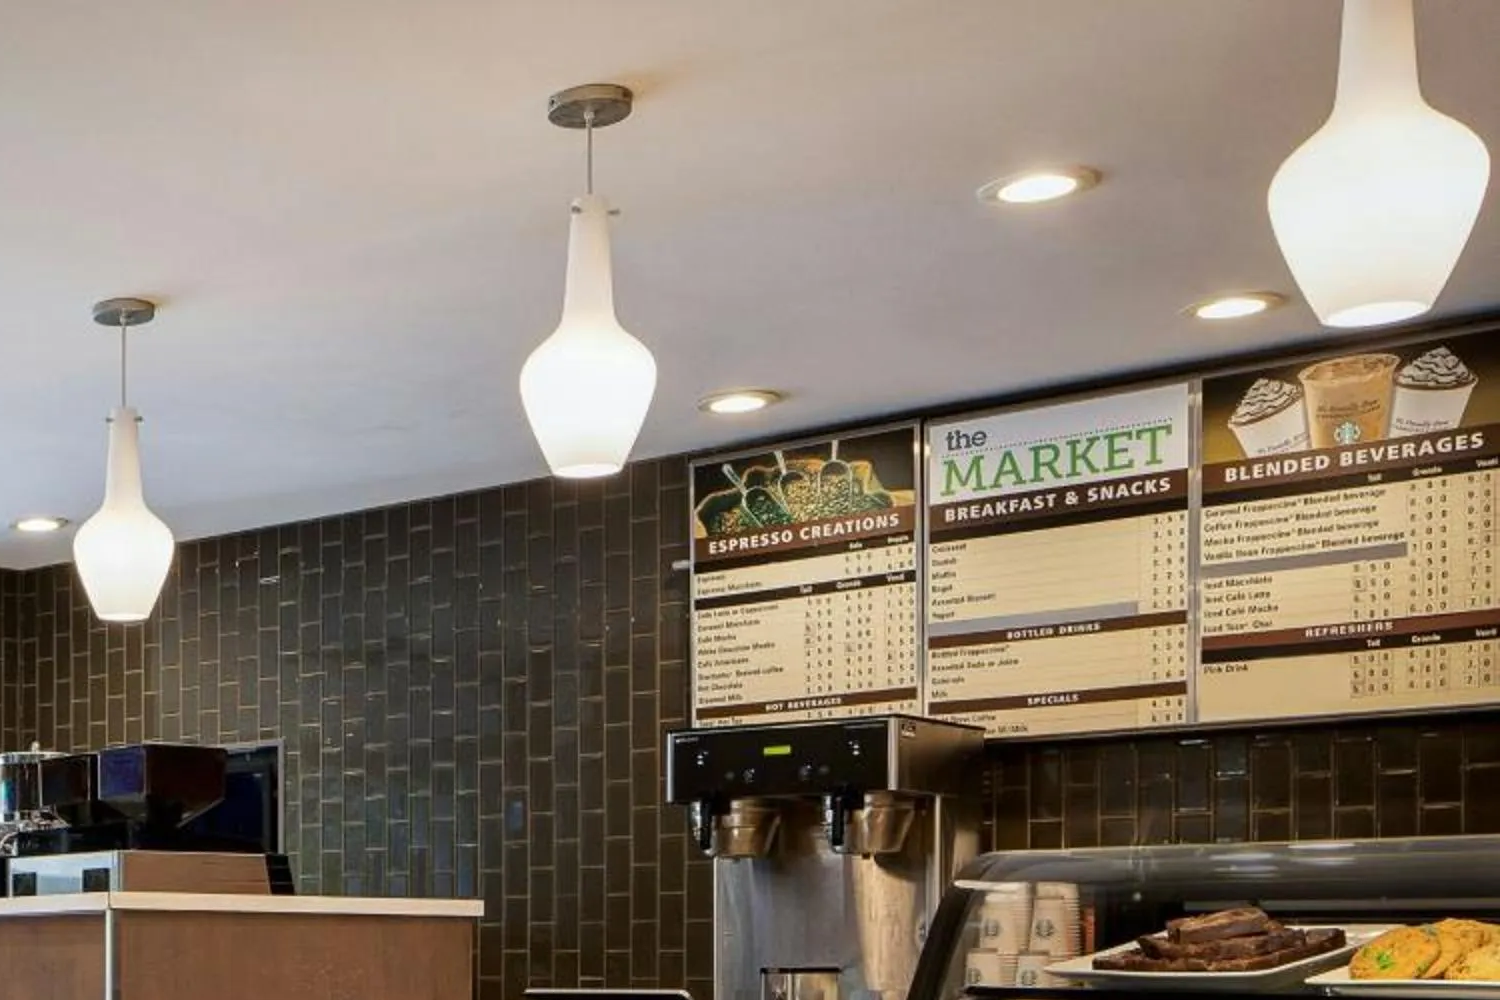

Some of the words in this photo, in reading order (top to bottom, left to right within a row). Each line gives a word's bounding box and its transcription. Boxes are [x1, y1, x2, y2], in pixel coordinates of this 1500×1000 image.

[940, 424, 1173, 497] MARKET
[946, 429, 988, 451] the
[1224, 455, 1331, 484] BLENDED
[1339, 431, 1485, 467] BEVERAGES
[944, 493, 1058, 523] BREAKFAST
[1064, 490, 1080, 505] &
[1087, 476, 1172, 504] SNACKS
[708, 530, 793, 555] ESPRESSO
[800, 513, 900, 540] CREATIONS
